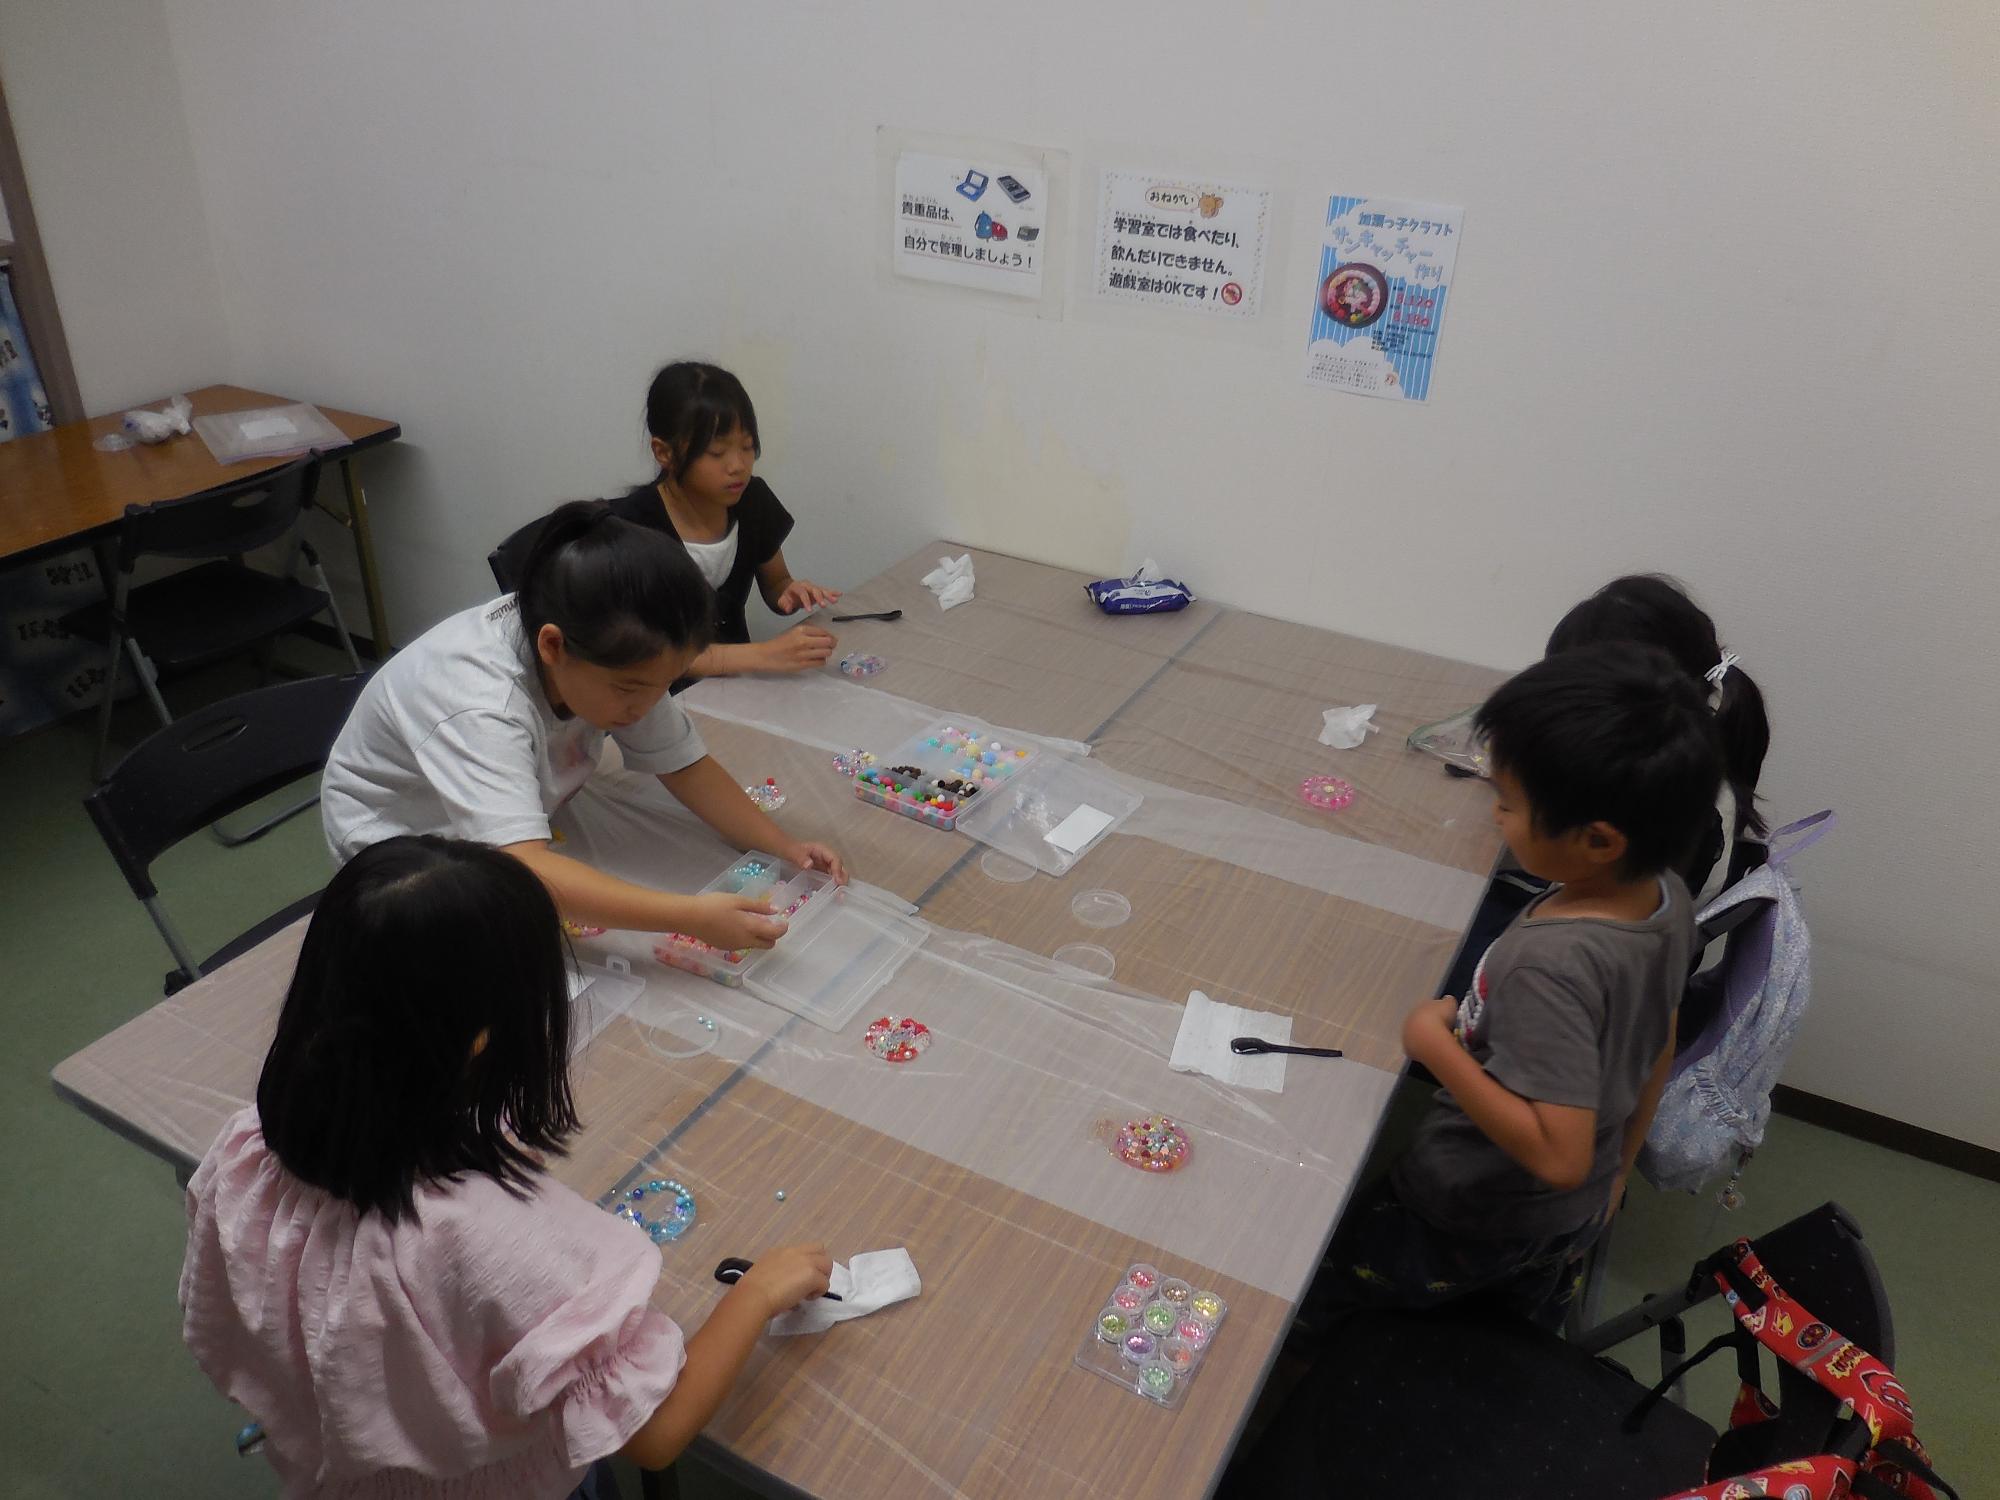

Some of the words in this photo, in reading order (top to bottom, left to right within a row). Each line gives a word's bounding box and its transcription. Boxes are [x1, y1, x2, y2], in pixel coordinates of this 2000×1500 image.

[902, 201, 955, 222] 貴重品は、
[1149, 191, 1194, 206] おねがい
[1113, 216, 1239, 249] 学習室では食べたり、
[1111, 245, 1233, 277] 飲んだりできません。
